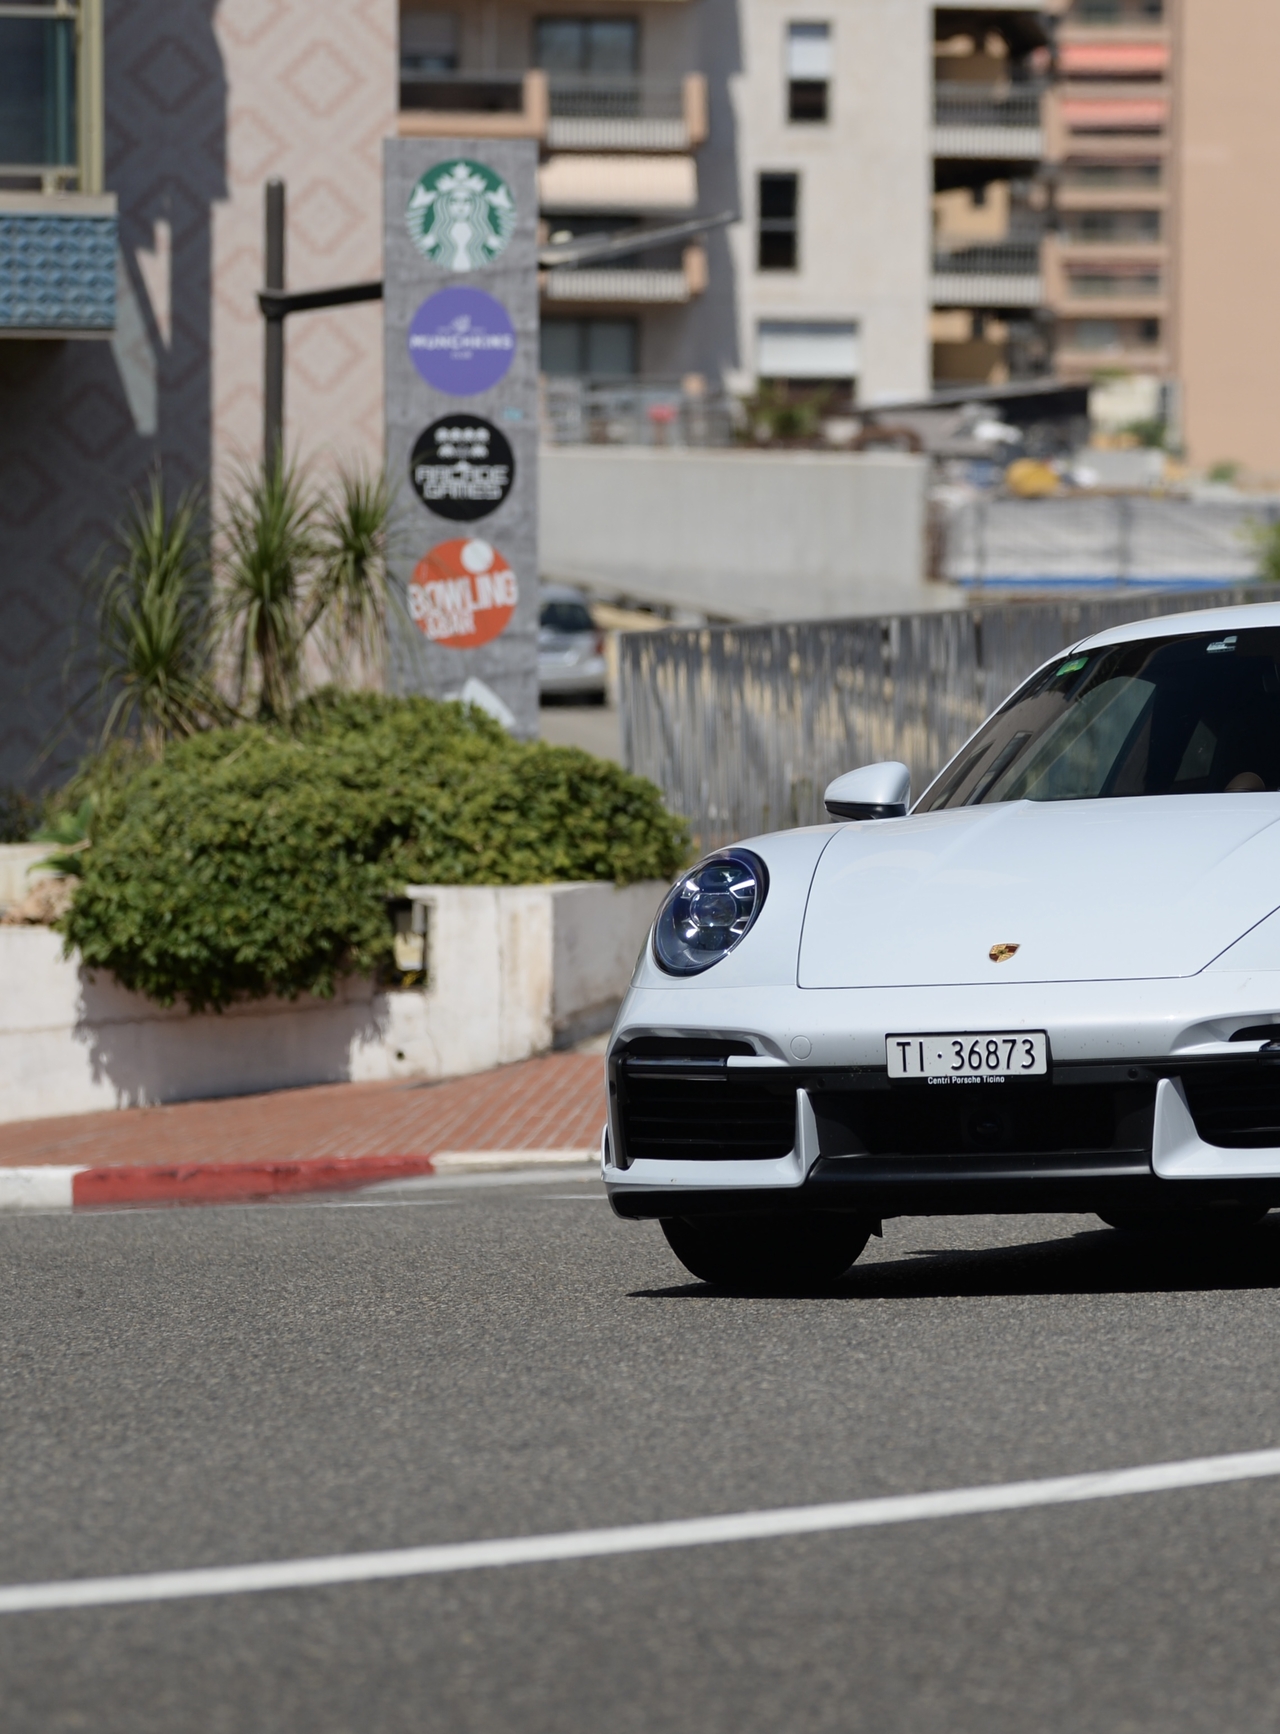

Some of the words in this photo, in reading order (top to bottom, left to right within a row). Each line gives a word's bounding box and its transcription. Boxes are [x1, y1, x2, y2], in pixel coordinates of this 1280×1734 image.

[415, 464, 508, 485] ARCADE
[423, 484, 502, 500] GAMES
[408, 569, 519, 621] BOWLING
[896, 1041, 925, 1073] TI
[951, 1038, 1036, 1071] 36873
[927, 1076, 951, 1085] Centri
[952, 1075, 981, 1084] Porsche
[982, 1075, 1005, 1083] Ticino
